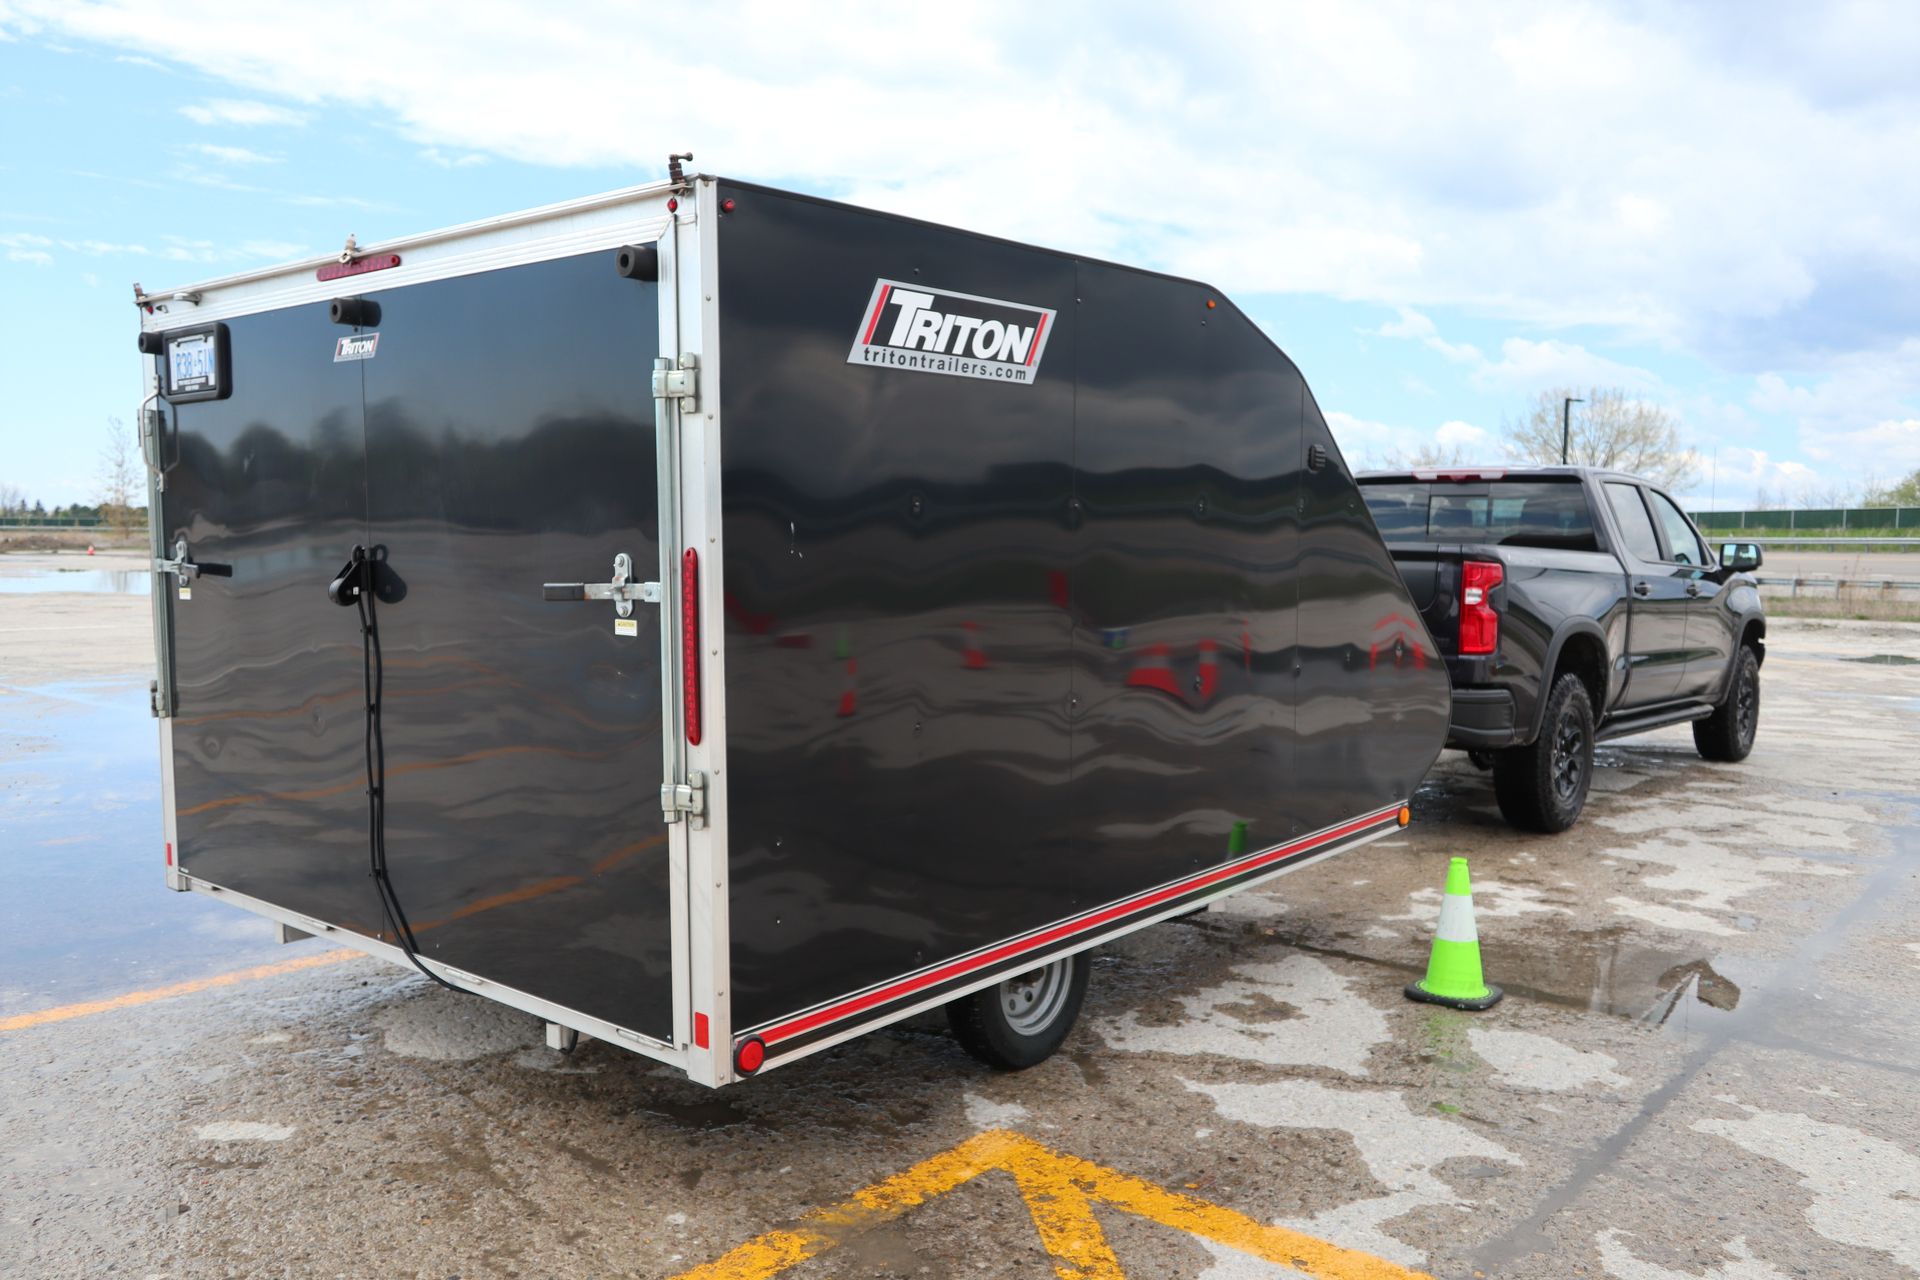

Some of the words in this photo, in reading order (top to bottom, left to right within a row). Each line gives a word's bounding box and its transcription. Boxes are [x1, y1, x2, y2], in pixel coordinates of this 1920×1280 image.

[888, 289, 1035, 363] TRITON
[341, 338, 375, 355] TRITON
[863, 347, 1027, 380] tritontrailers.com
